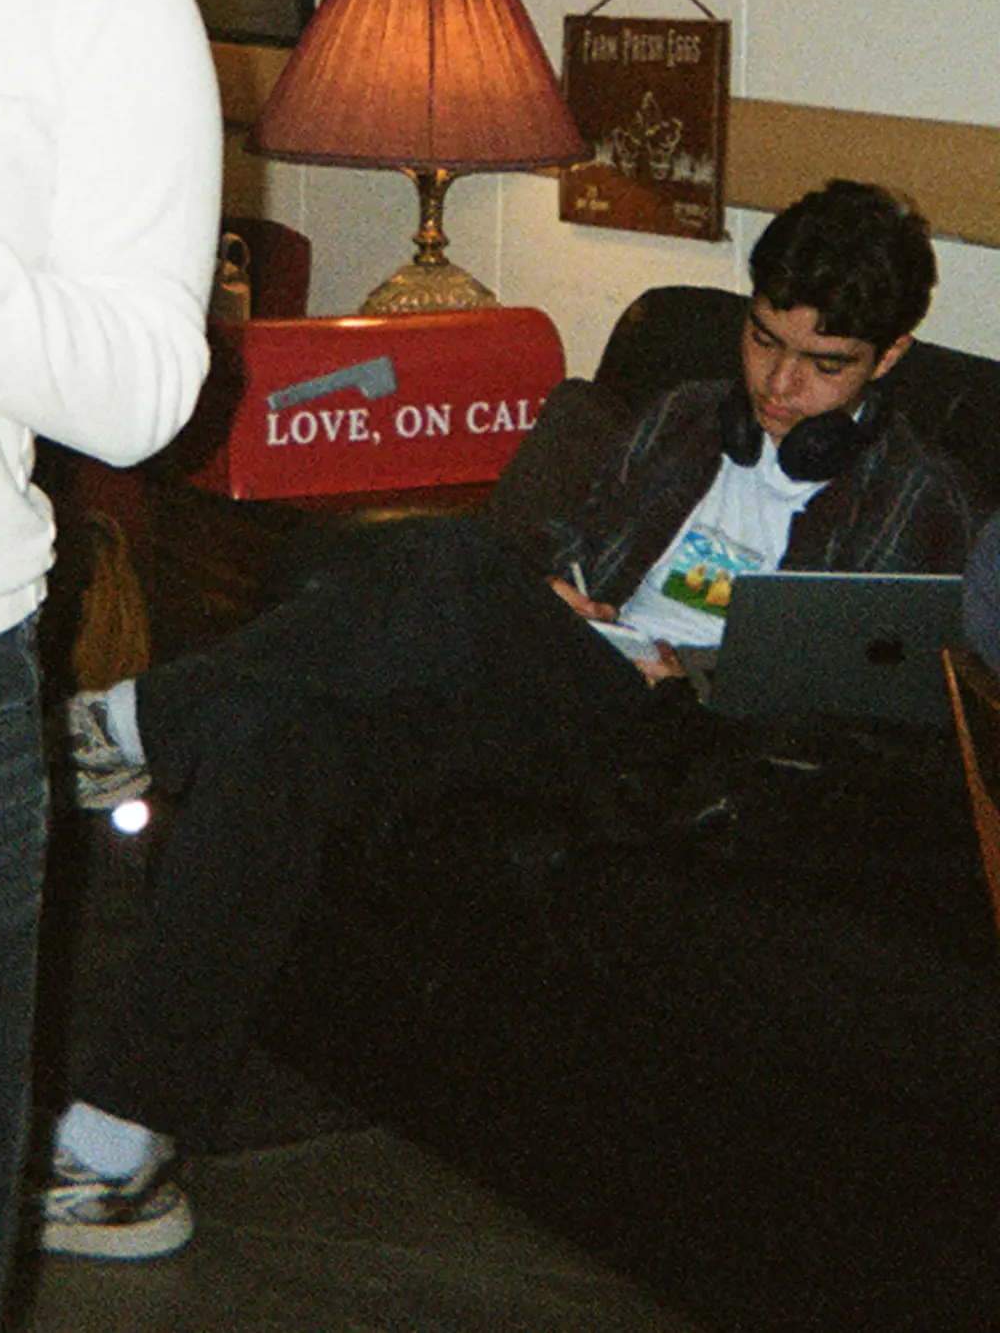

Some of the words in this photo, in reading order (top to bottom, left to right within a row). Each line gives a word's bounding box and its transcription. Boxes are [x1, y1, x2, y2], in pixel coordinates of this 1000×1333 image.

[266, 408, 381, 446] LOVE,
[395, 404, 452, 438] ON
[466, 397, 546, 434] CAL
